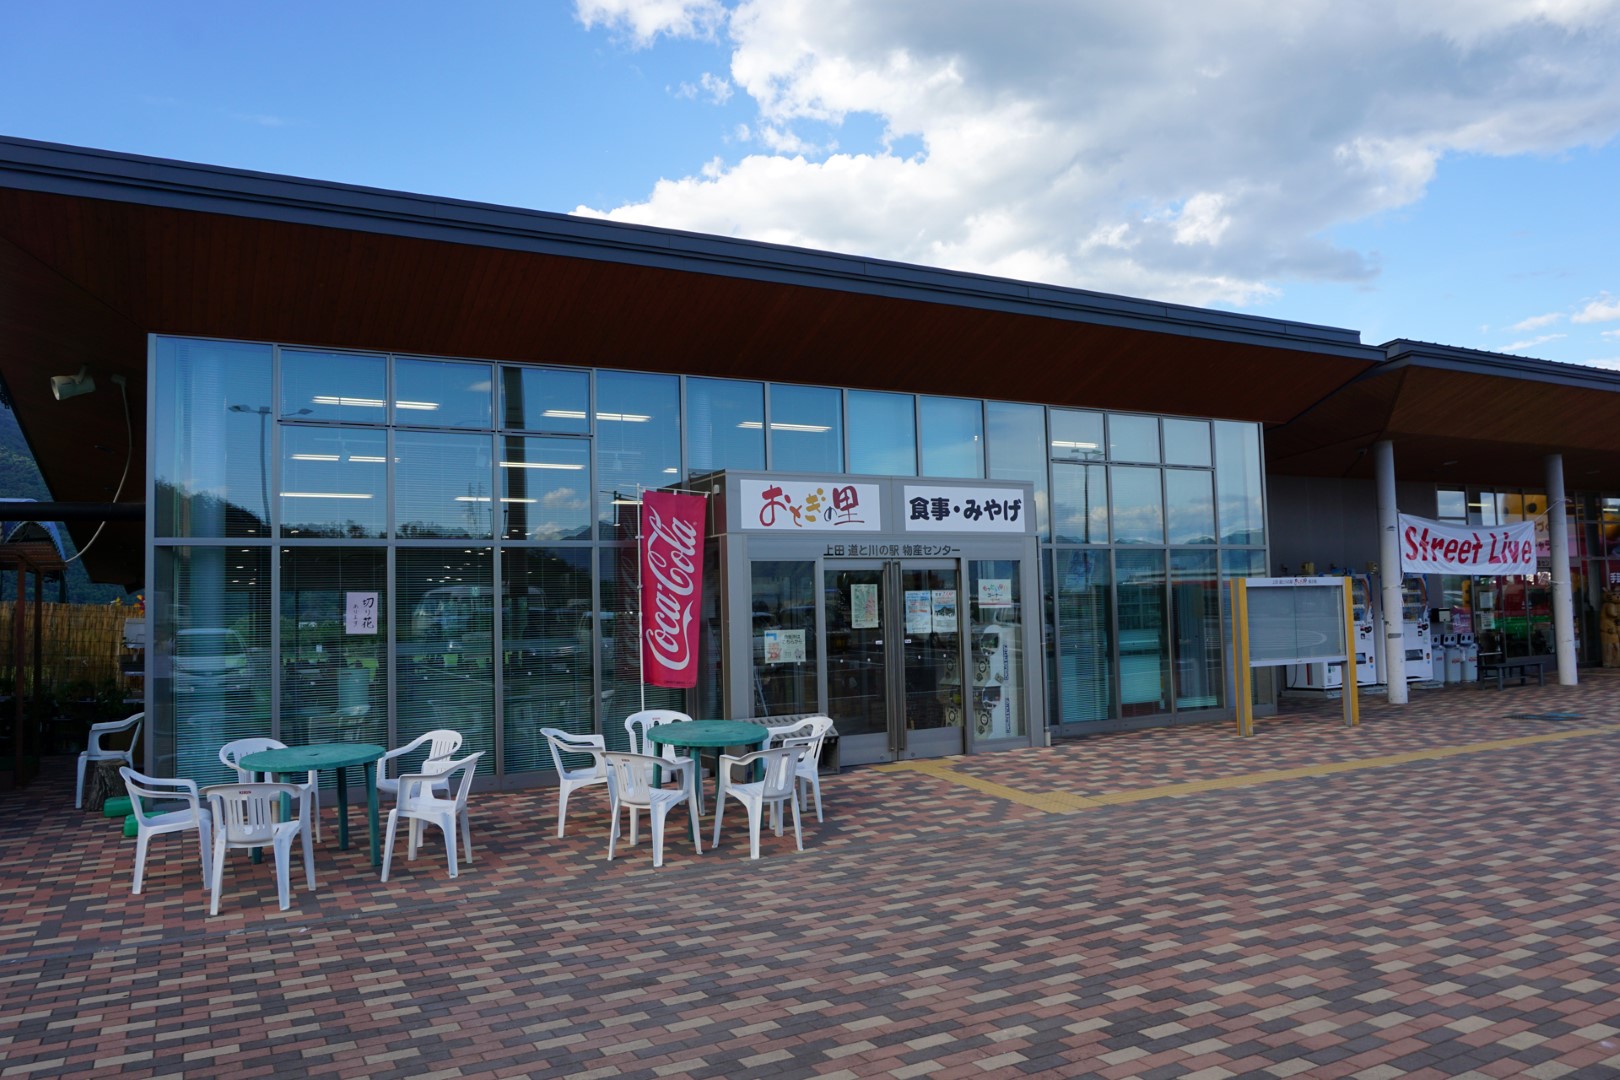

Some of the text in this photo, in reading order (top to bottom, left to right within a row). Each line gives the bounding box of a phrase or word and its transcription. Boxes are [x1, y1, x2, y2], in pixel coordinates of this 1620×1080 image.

[759, 484, 865, 527] おとぎの里
[909, 496, 1022, 521] 食事・みやげ
[823, 544, 960, 556] 上田 道と川の駅 物産センター
[1405, 526, 1532, 564] Street Live
[645, 505, 697, 670] Coca-Cola
[363, 597, 375, 628] 切り花
